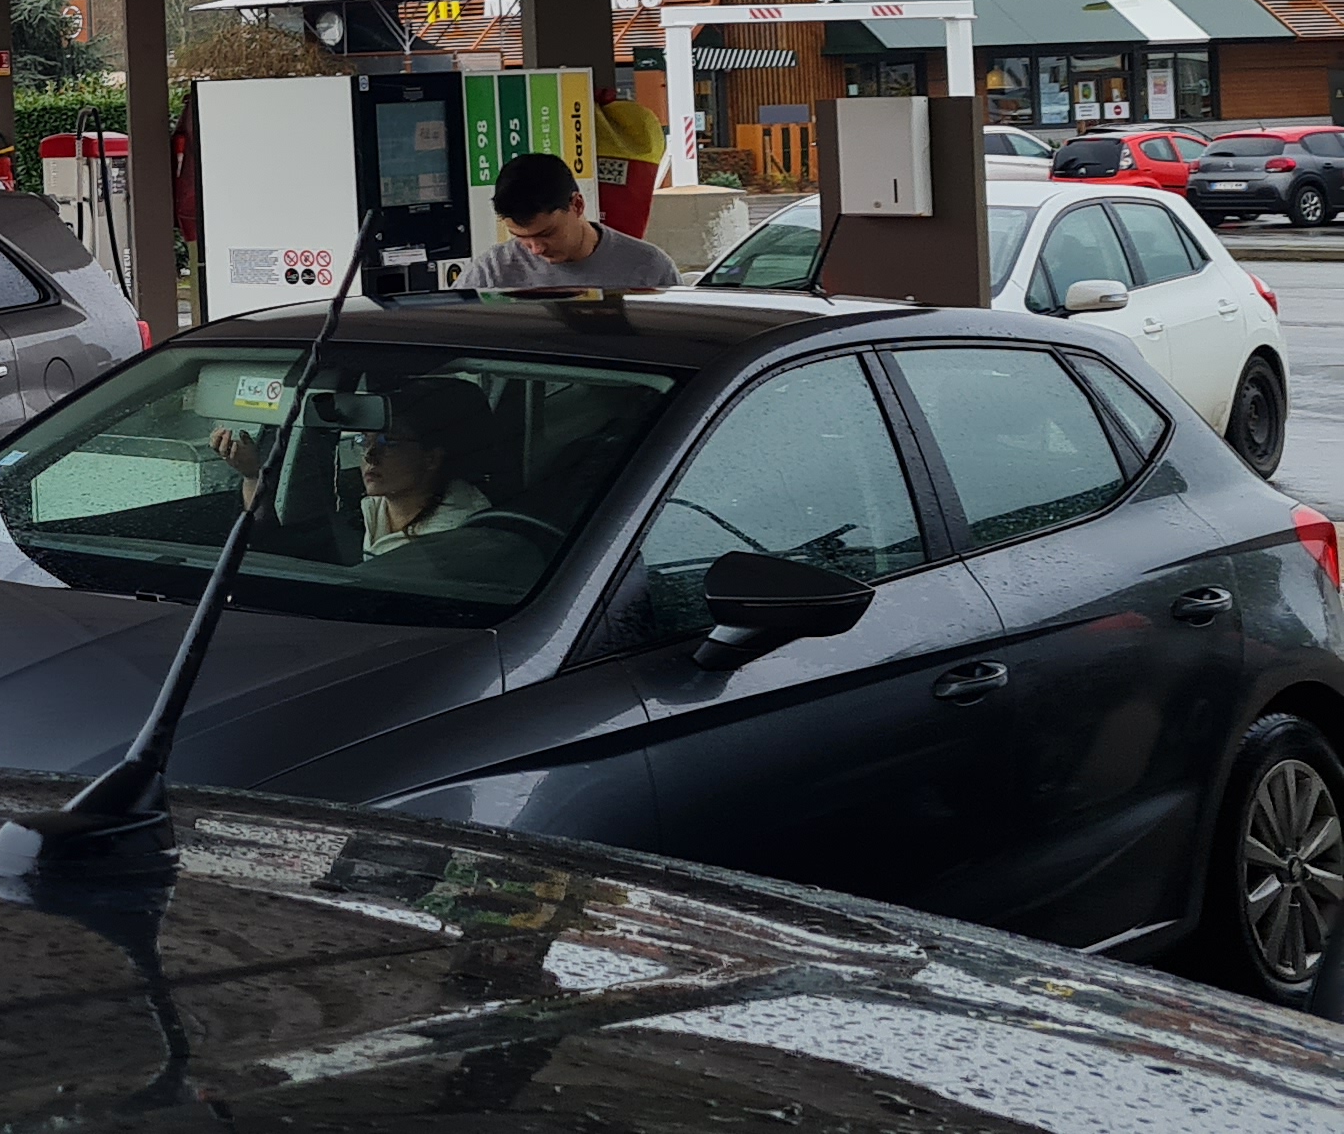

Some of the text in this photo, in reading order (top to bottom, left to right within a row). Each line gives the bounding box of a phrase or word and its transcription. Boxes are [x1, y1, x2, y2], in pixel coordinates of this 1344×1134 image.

[476, 119, 491, 182] SP 98
[508, 117, 521, 147] 95
[571, 100, 585, 175] Gazole
